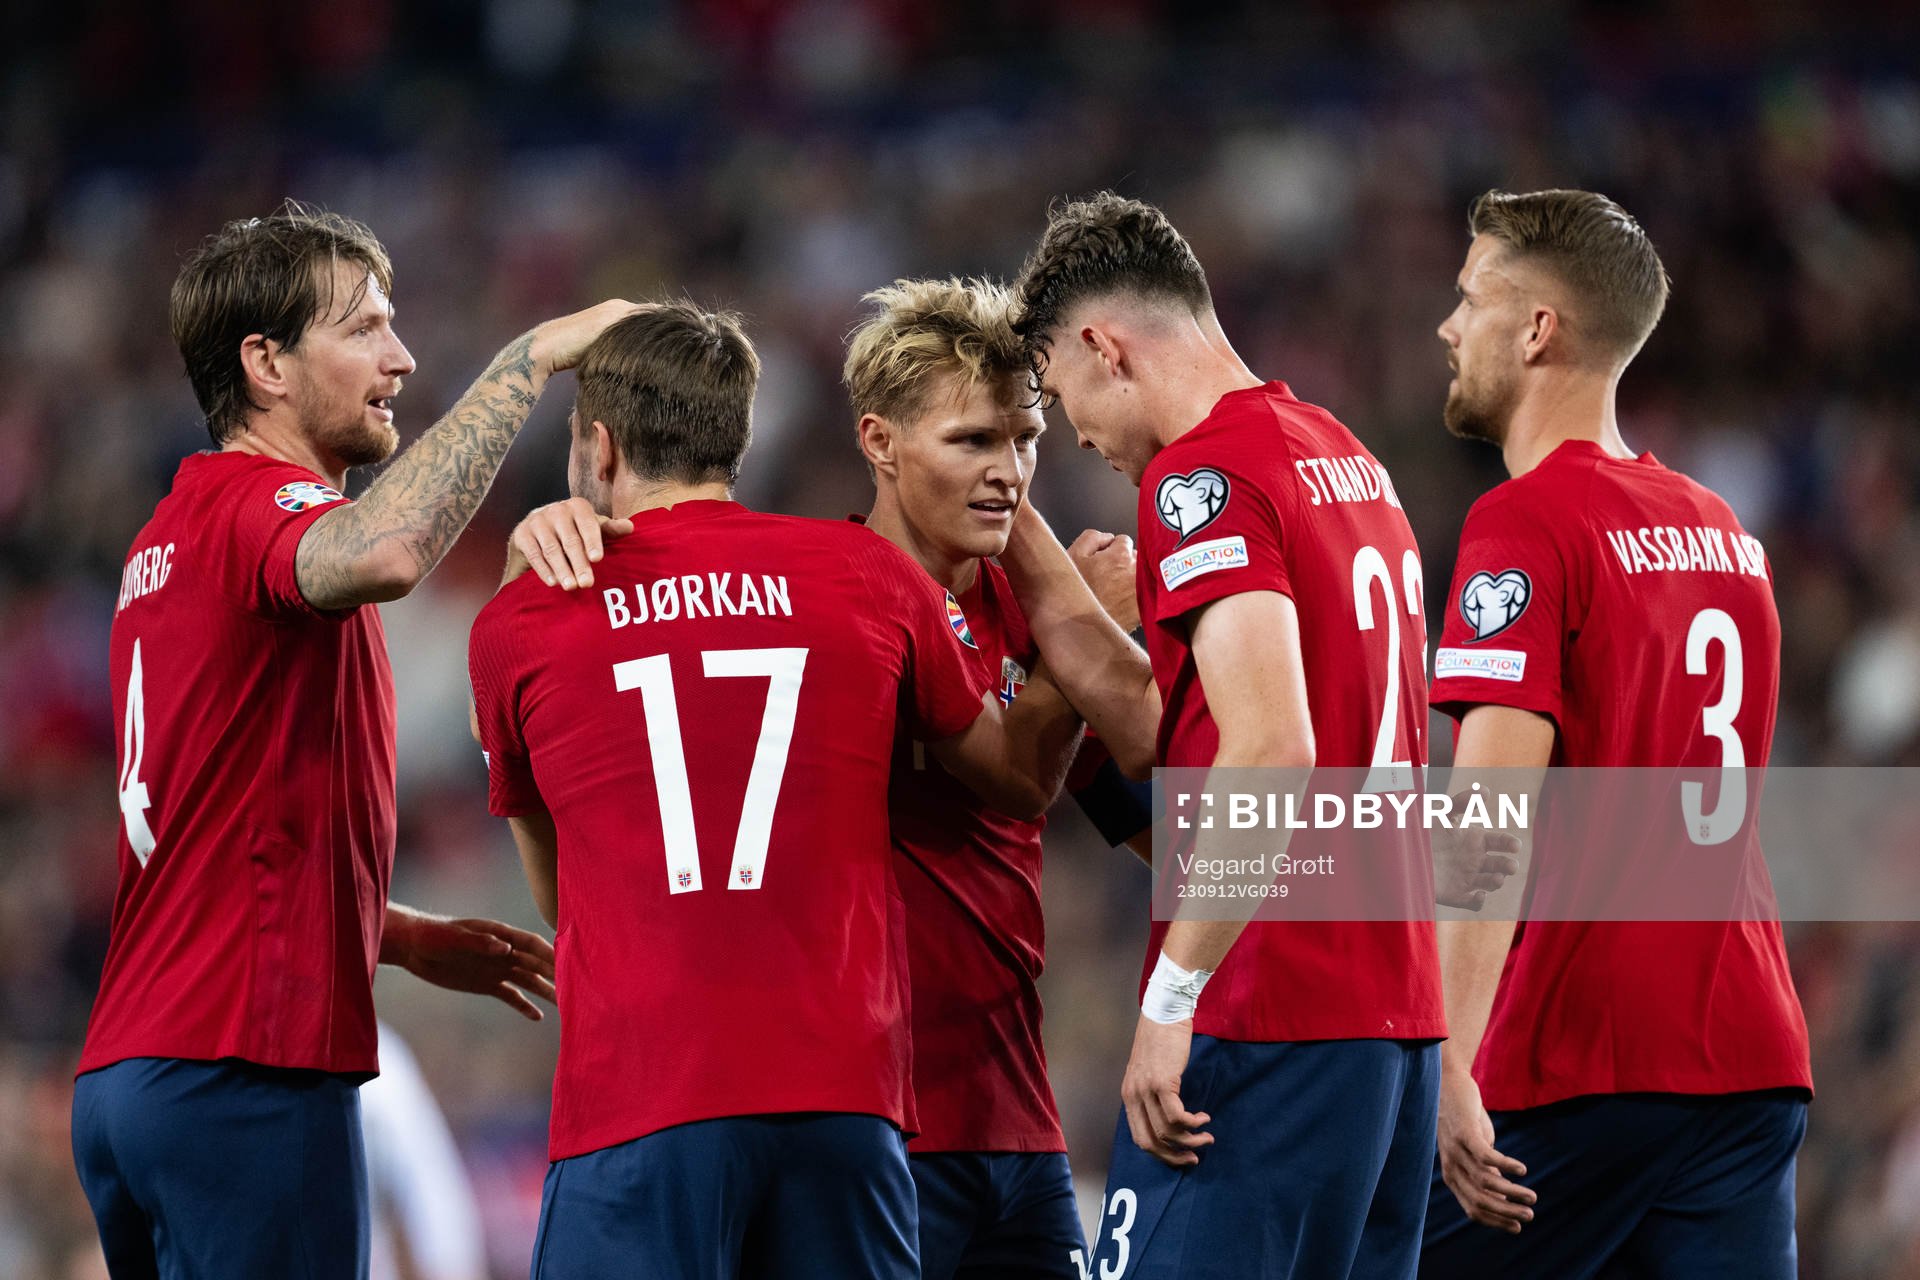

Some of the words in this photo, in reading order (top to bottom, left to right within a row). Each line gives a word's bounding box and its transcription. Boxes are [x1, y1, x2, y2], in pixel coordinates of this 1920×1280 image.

[1295, 455, 1380, 506] STRAND
[1163, 546, 1244, 580] FOUNDATION
[1606, 525, 1734, 574] VASSBAKK
[602, 571, 793, 630] BJØRKAN
[1436, 656, 1522, 671] FOUNDATION
[118, 637, 157, 869] 4
[1681, 608, 1747, 845] 3
[612, 647, 810, 895] 17
